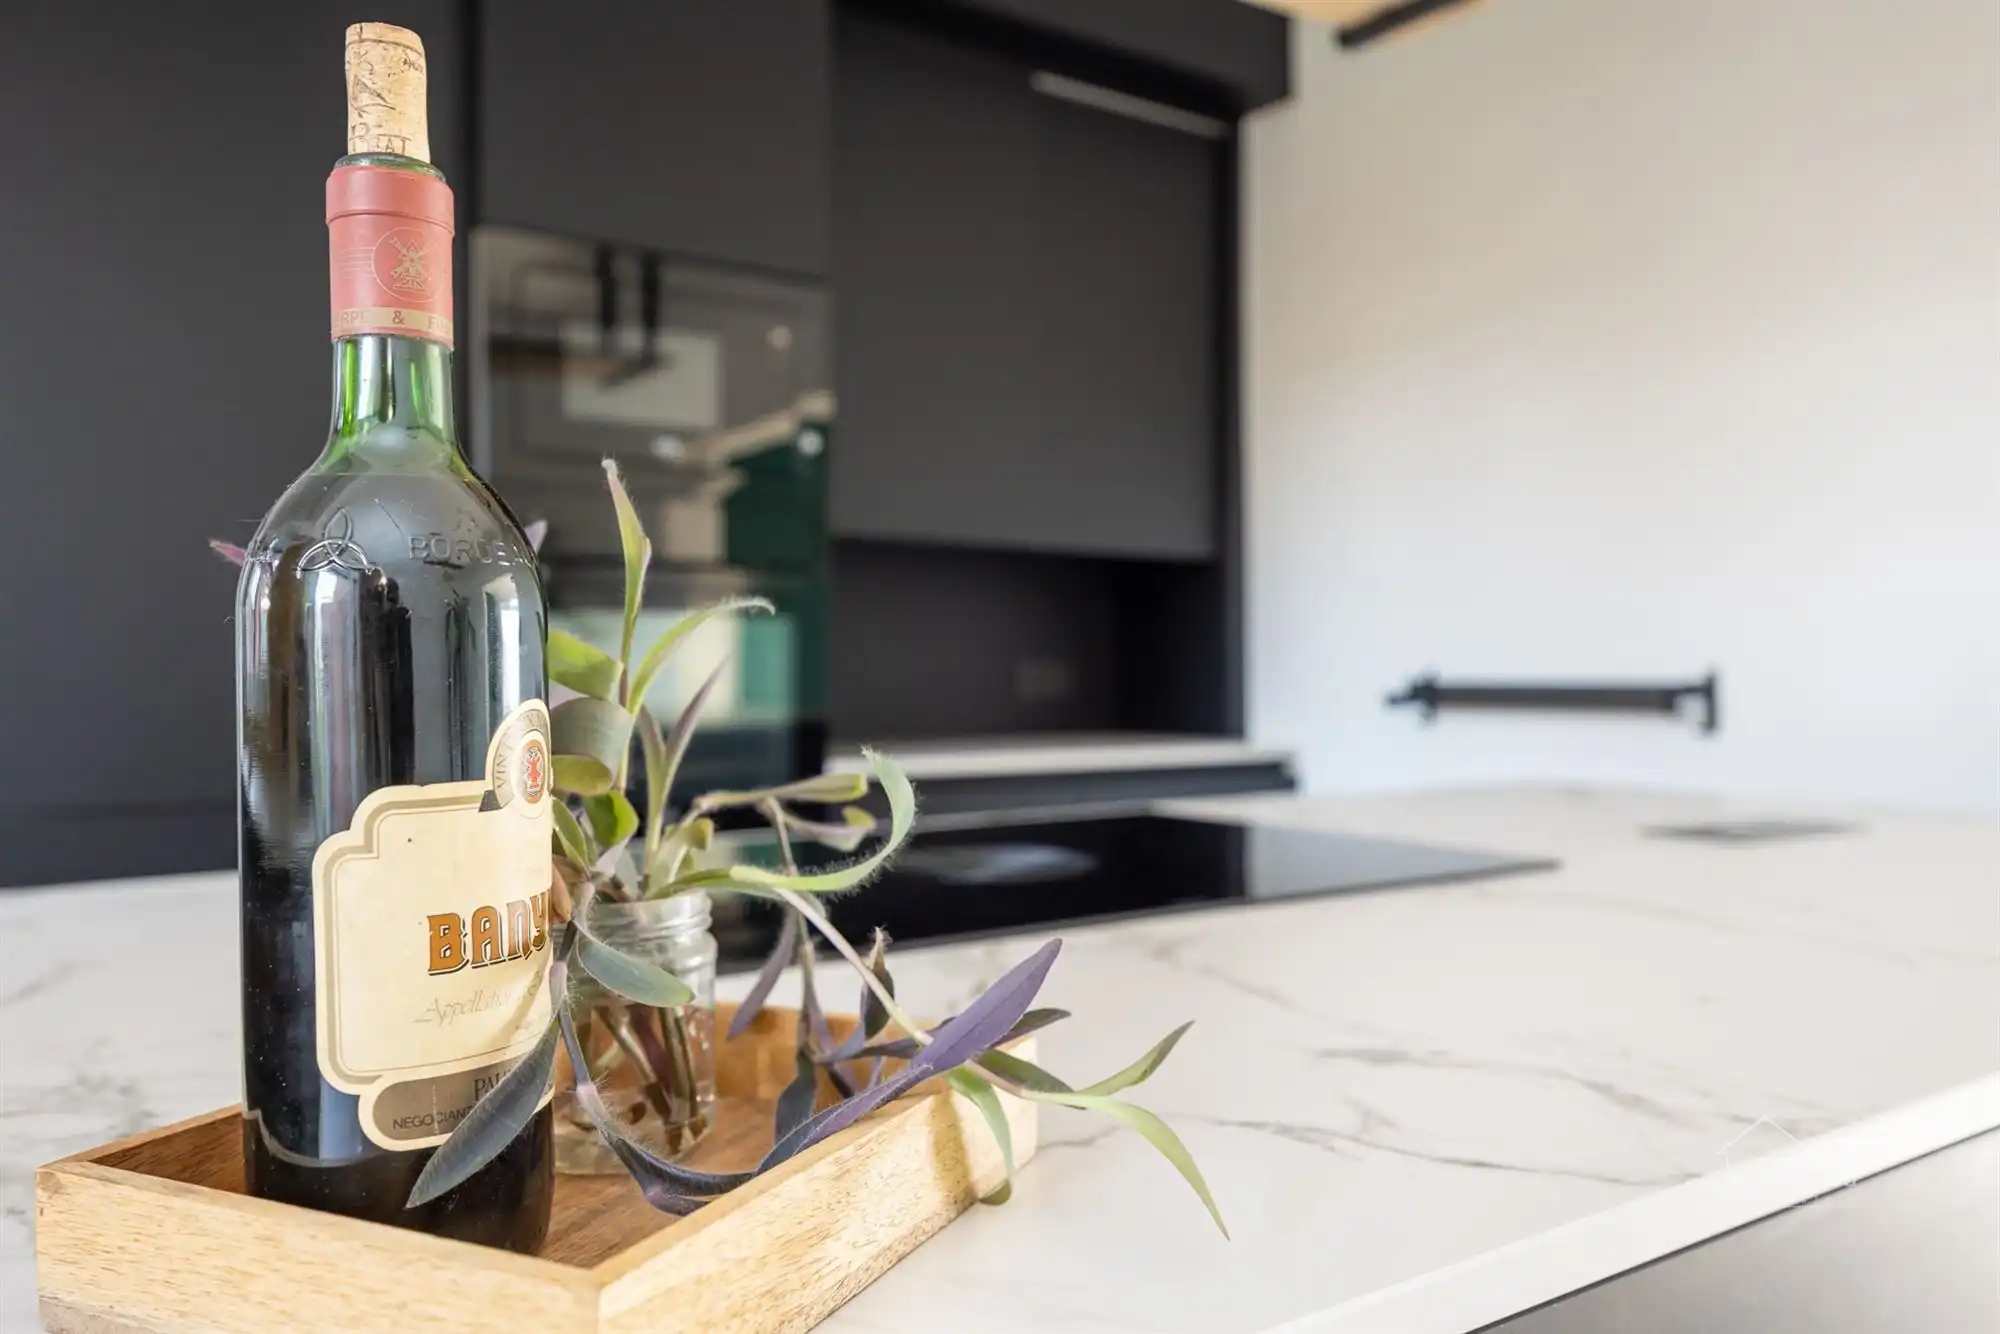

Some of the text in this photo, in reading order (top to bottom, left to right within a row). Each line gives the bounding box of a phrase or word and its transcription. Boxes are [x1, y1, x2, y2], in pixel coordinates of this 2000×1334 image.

[341, 309, 371, 326] RPE
[392, 310, 405, 326] &
[426, 889, 551, 976] BANY
[391, 1103, 477, 1131] NEGOCIANT
